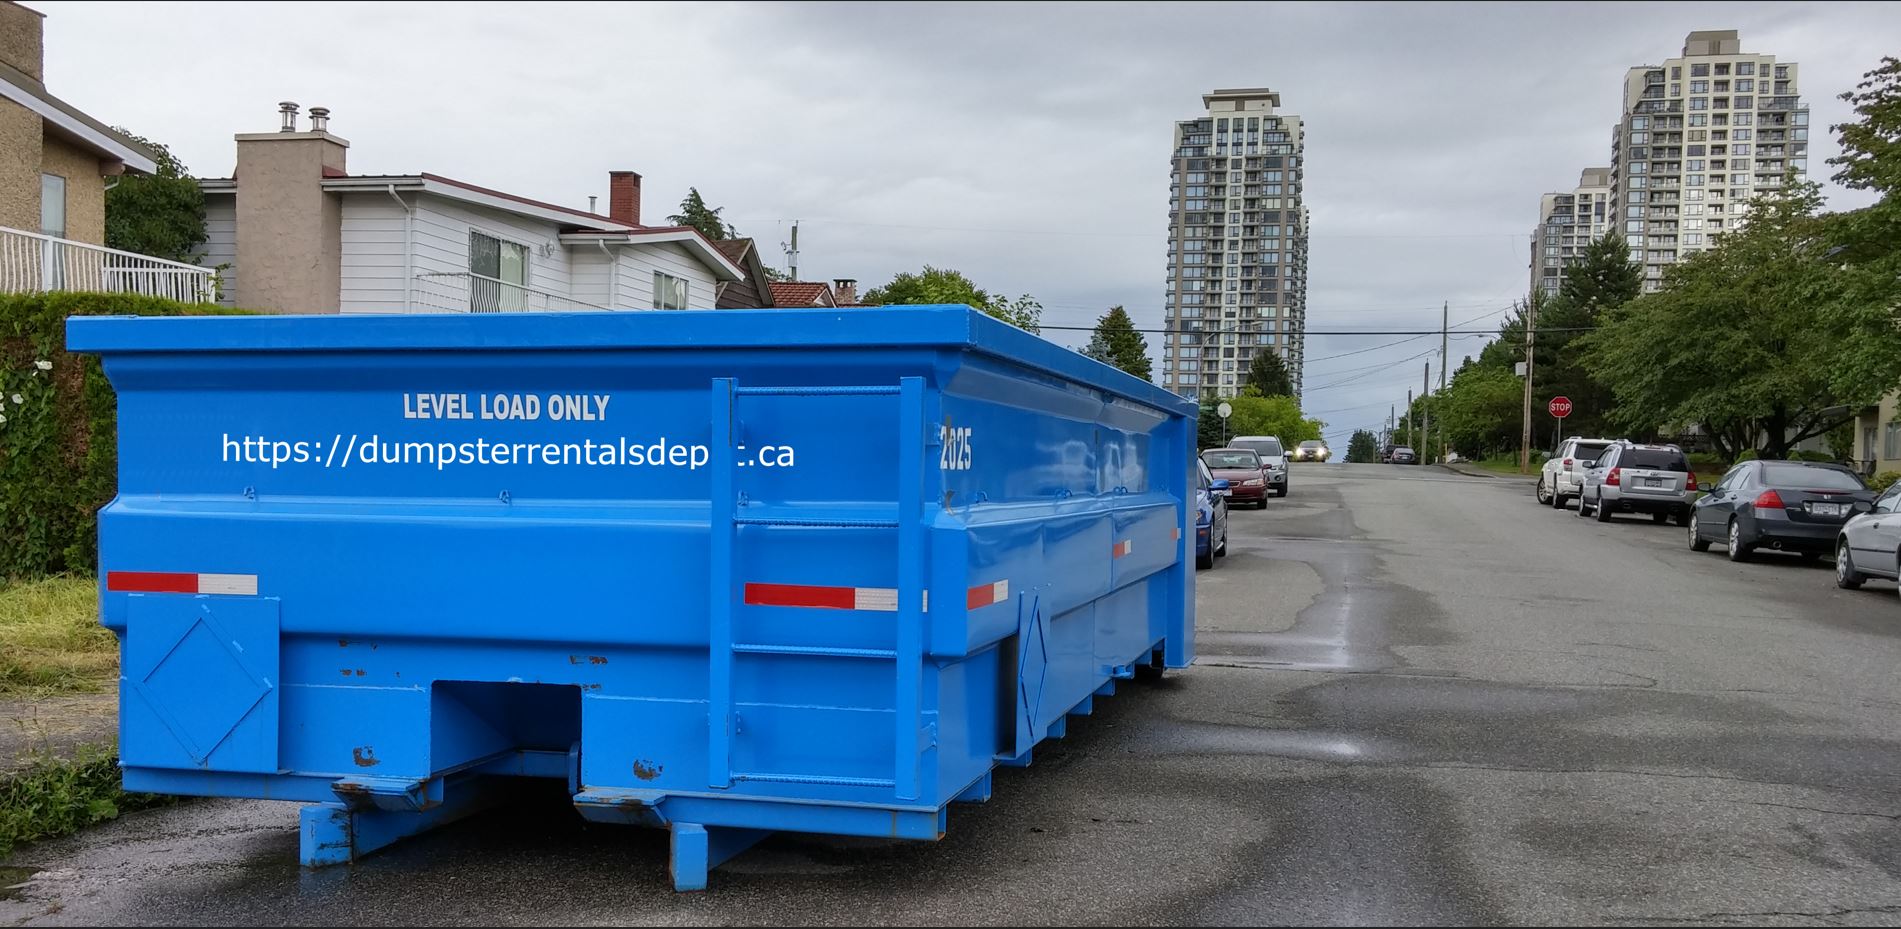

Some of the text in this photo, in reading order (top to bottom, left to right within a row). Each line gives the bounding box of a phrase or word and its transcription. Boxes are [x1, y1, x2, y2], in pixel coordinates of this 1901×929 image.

[403, 393, 611, 422] LEVEL LOAD ONLY
[1550, 402, 1571, 412] STOP
[940, 425, 972, 470] 2025
